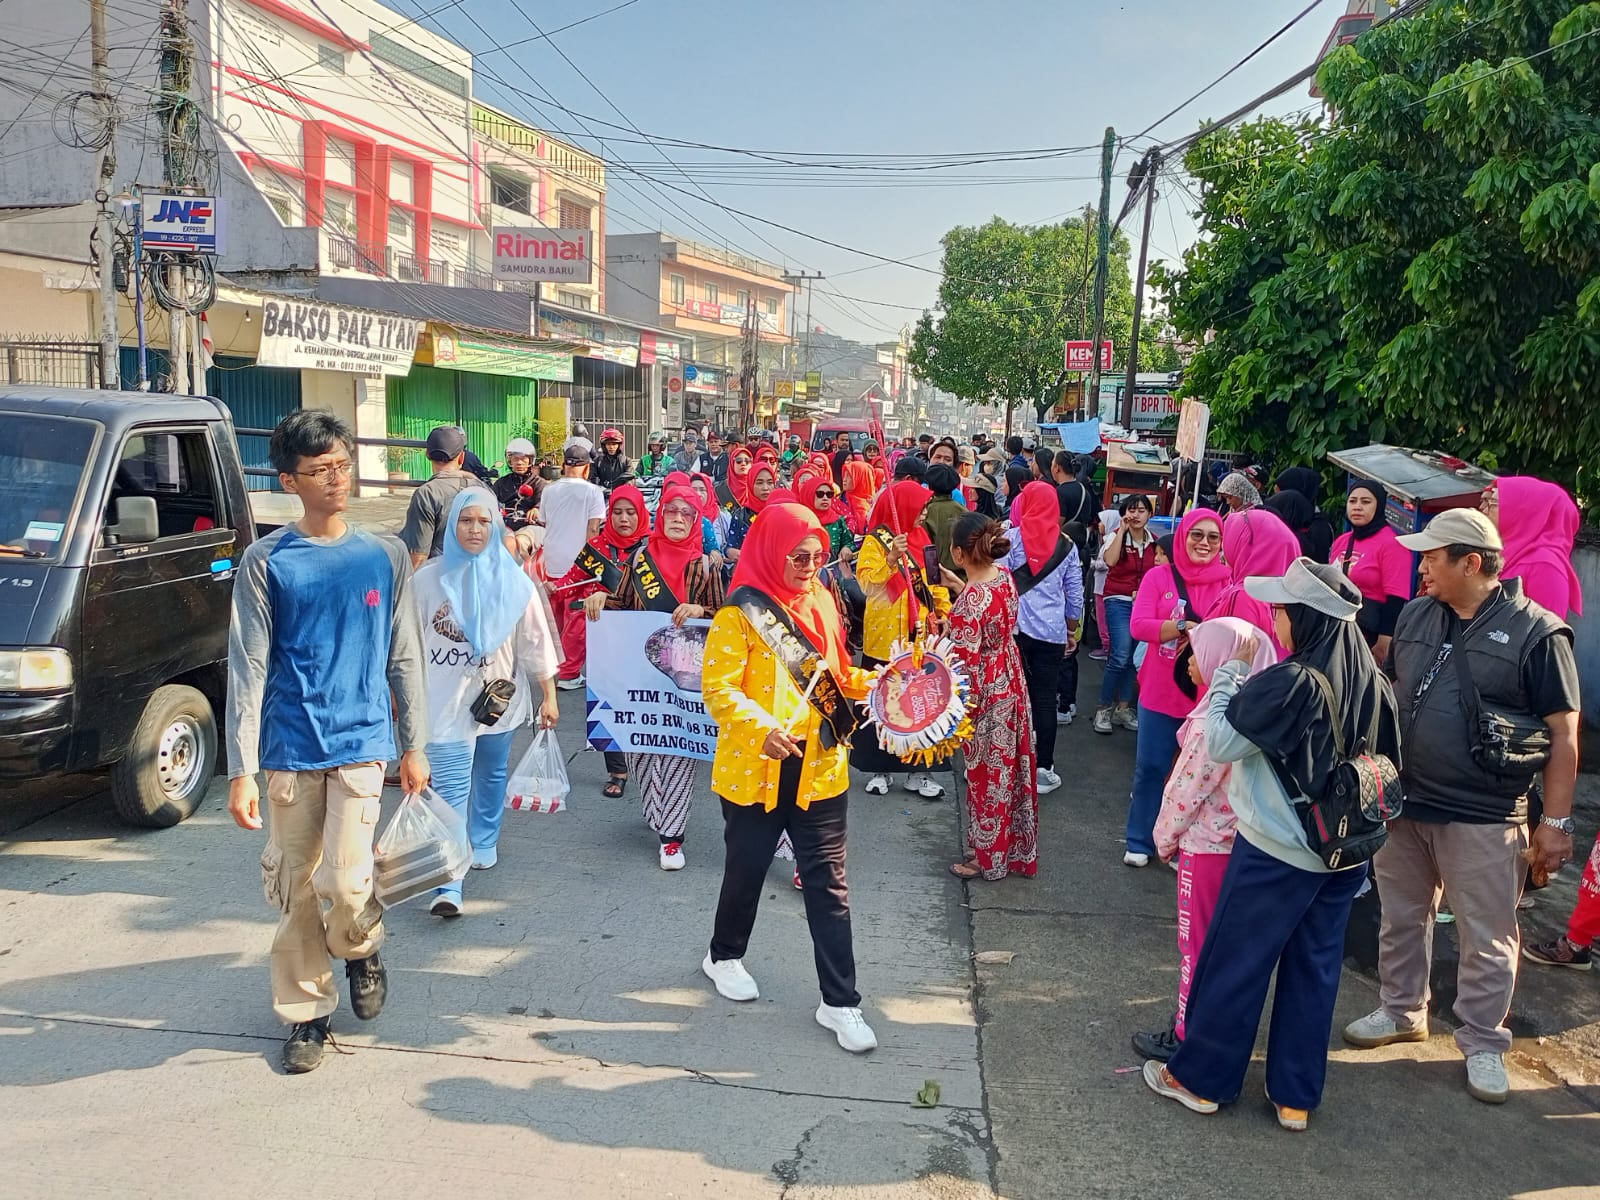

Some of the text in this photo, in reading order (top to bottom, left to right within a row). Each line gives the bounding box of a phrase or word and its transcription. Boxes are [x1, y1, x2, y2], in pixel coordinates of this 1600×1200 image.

[152, 200, 212, 224] JNE
[497, 233, 584, 260] Rinnai
[500, 264, 574, 275] SAMUDRA BARU
[264, 301, 331, 341] BAKSO
[337, 311, 373, 348] PAK
[378, 318, 416, 350] TI'AN
[327, 360, 336, 369] WA
[1141, 397, 1160, 413] BPR
[627, 690, 706, 714] TIM TABUH
[614, 711, 636, 724] RT.
[641, 714, 658, 725] 05
[662, 714, 685, 730] RW.
[686, 722, 700, 734] 08
[630, 732, 709, 754] CIMANGGIS
[1180, 869, 1193, 899] LIFE
[1179, 909, 1192, 942] LOVE
[1179, 992, 1188, 1021] LIFE
